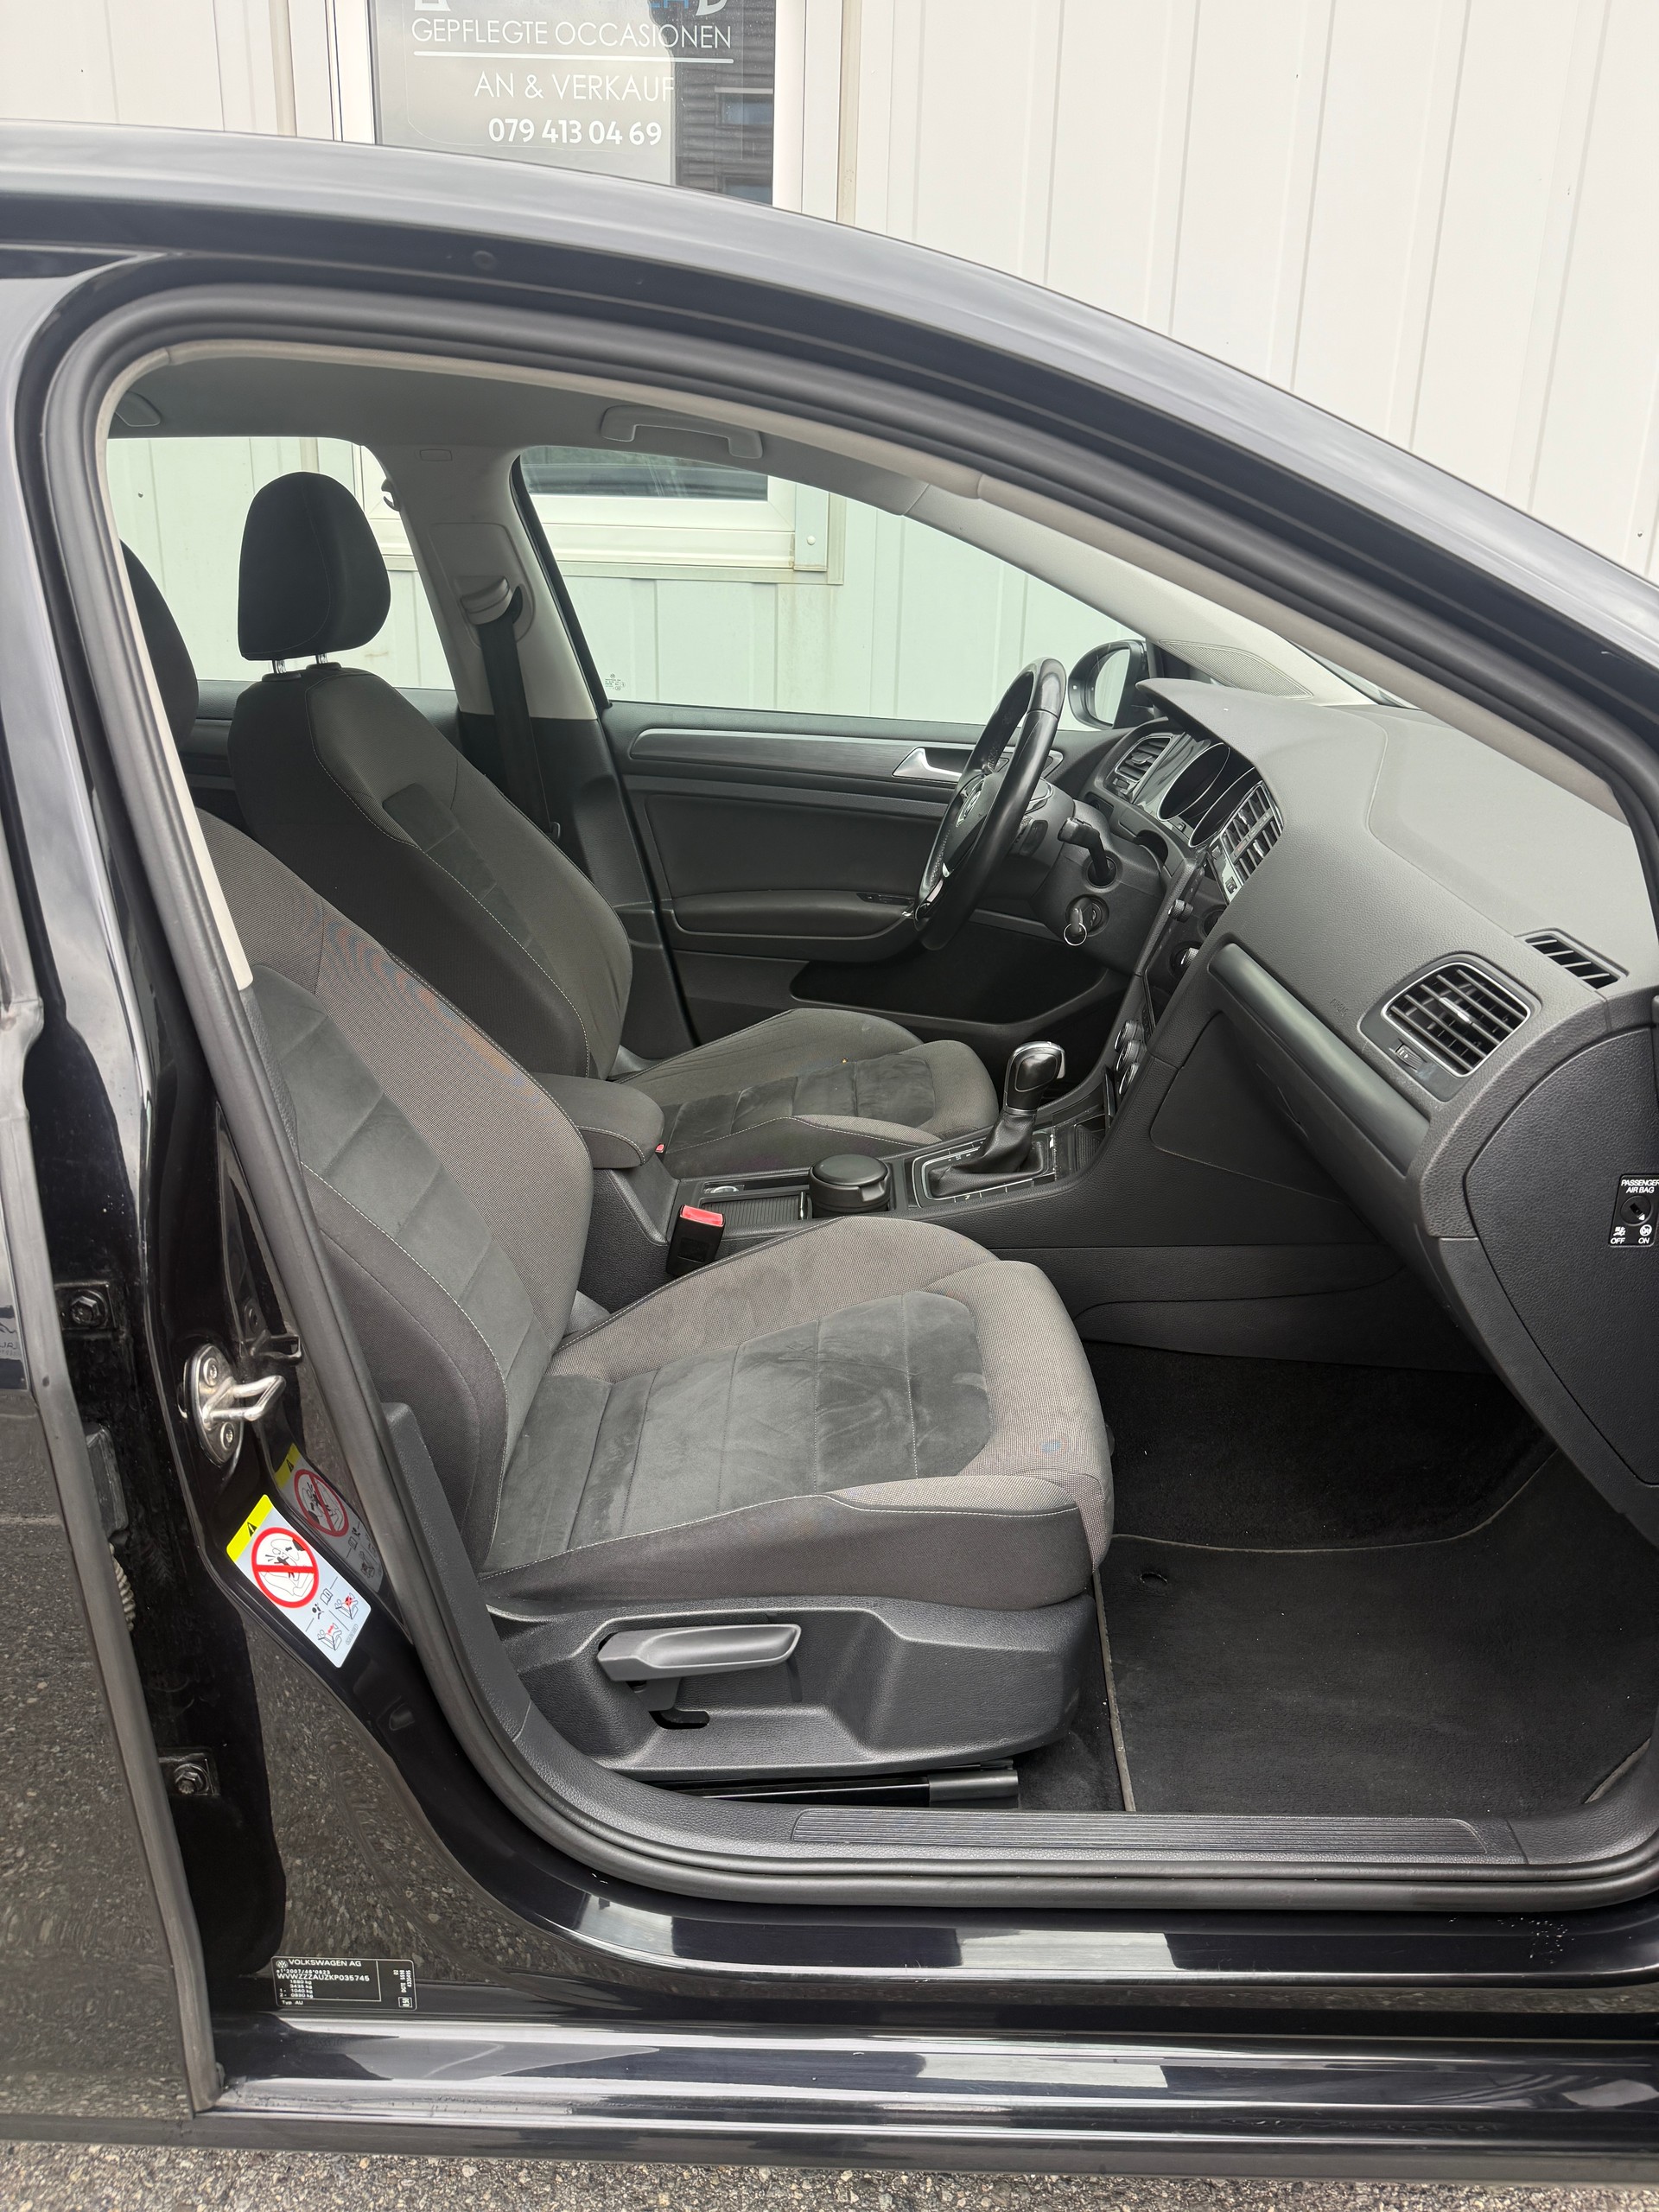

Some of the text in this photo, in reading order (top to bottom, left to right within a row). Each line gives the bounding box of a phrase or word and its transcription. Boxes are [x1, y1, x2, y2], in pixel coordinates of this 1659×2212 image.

[410, 17, 732, 49] GEPFLEGTE OCCASIONEN
[474, 71, 675, 102] AN & VERKAUF
[488, 118, 662, 146] 079 413 04 69
